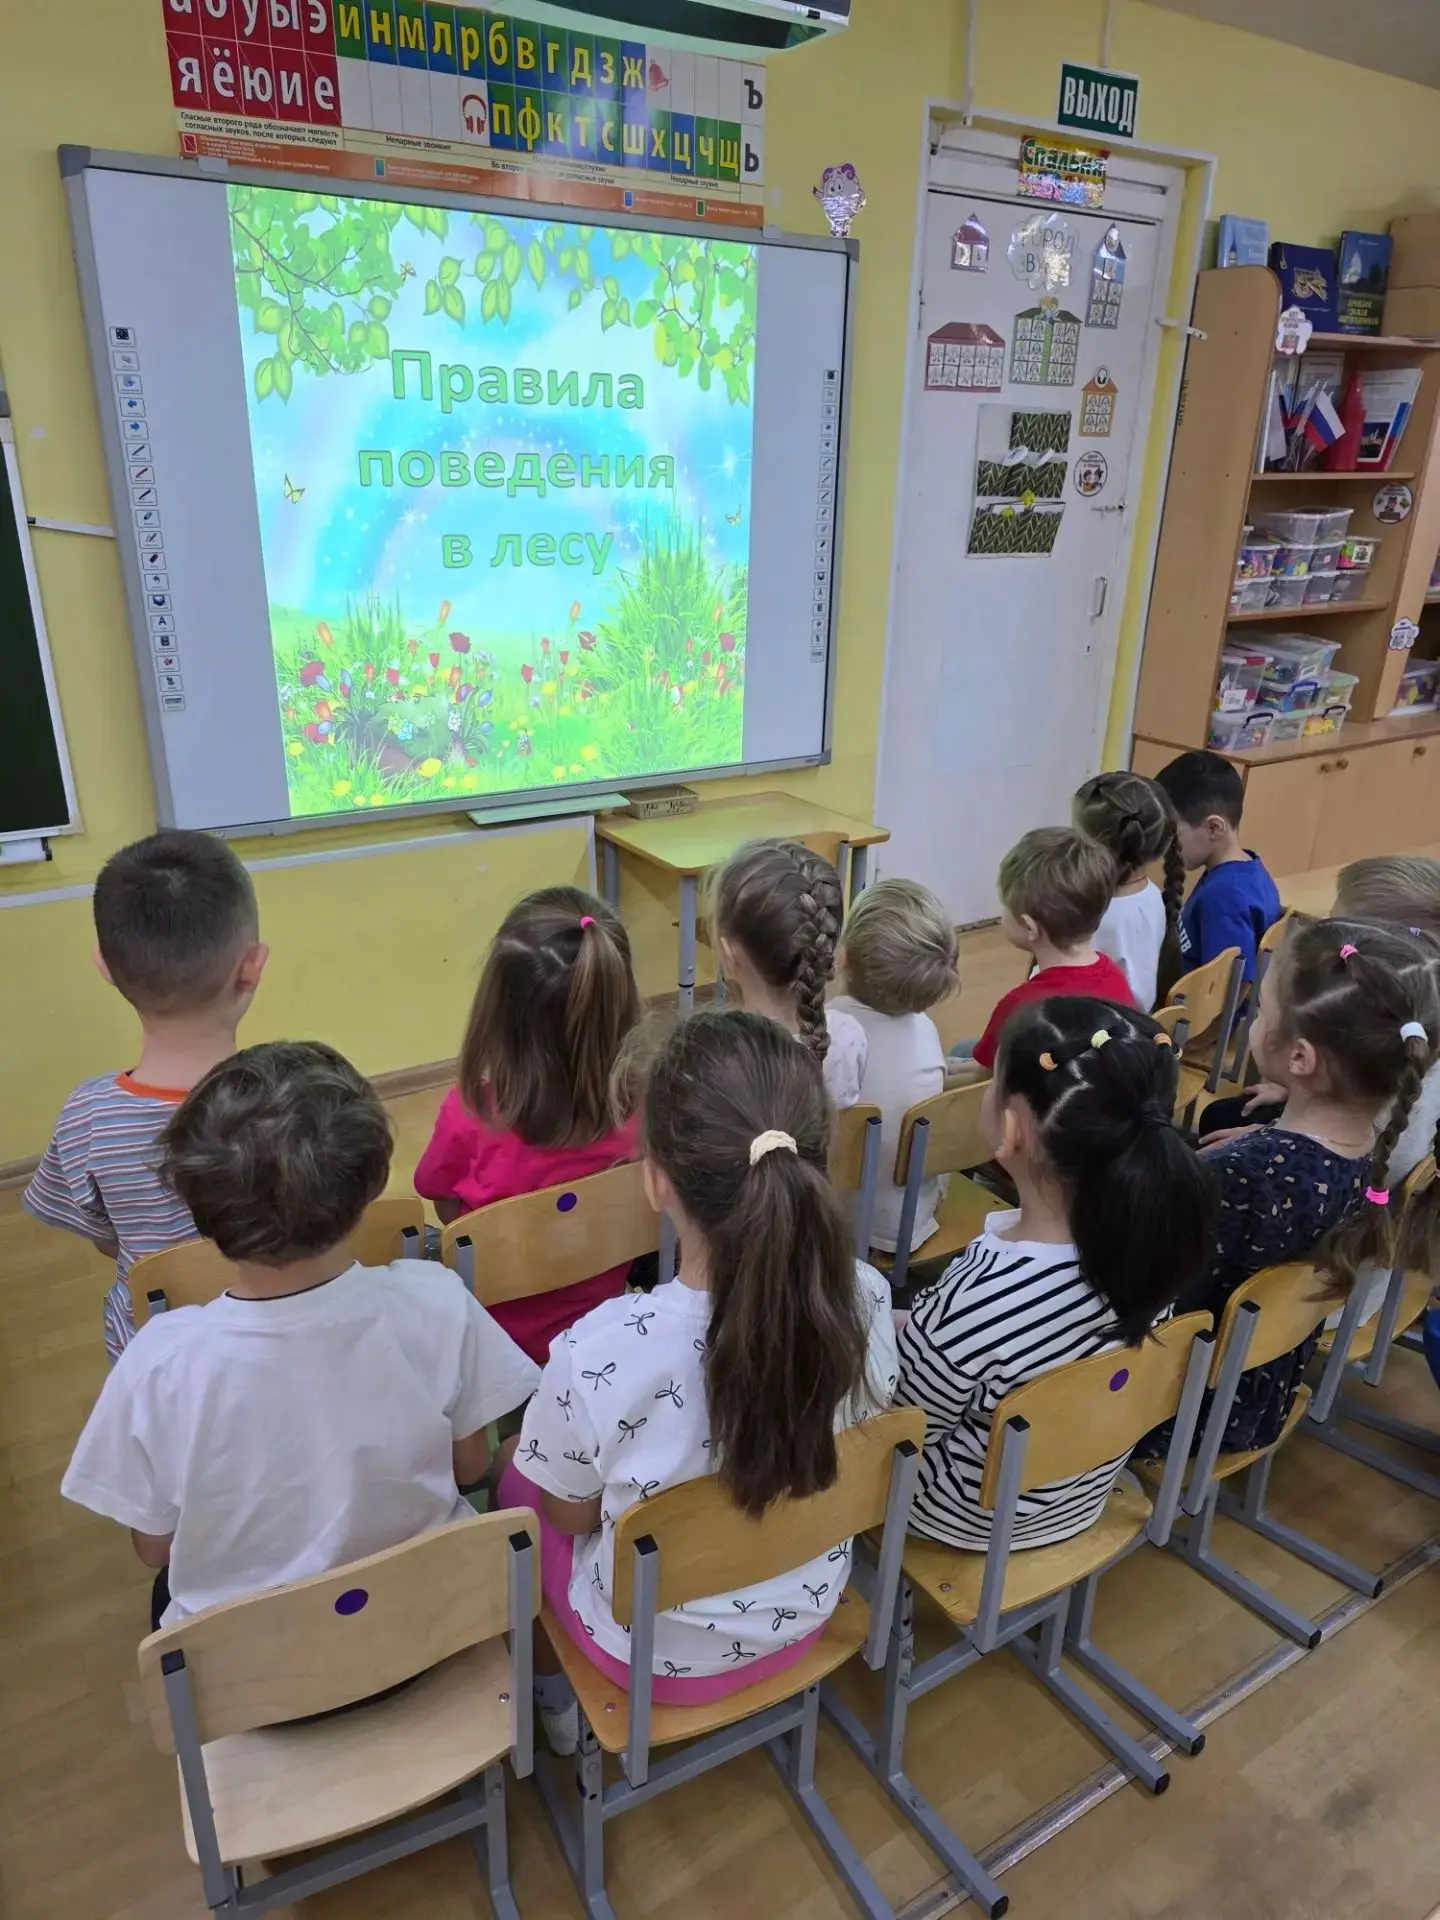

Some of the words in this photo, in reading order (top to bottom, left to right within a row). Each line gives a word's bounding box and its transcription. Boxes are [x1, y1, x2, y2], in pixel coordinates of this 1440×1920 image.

[180, 111, 212, 123] Гласные
[213, 116, 242, 127] второго
[244, 120, 262, 131] ряда
[263, 123, 307, 134] обозначают
[308, 127, 339, 138] мягкость
[1062, 76, 1135, 133] ВЫХОД
[184, 121, 223, 132] согласных
[252, 129, 274, 139] после
[276, 132, 306, 143] которых
[307, 136, 337, 146] следуют
[386, 135, 421, 147] Непарные
[391, 349, 644, 414] Правила
[358, 450, 675, 497] поведения
[442, 534, 473, 568] в
[490, 532, 613, 575] лесу
